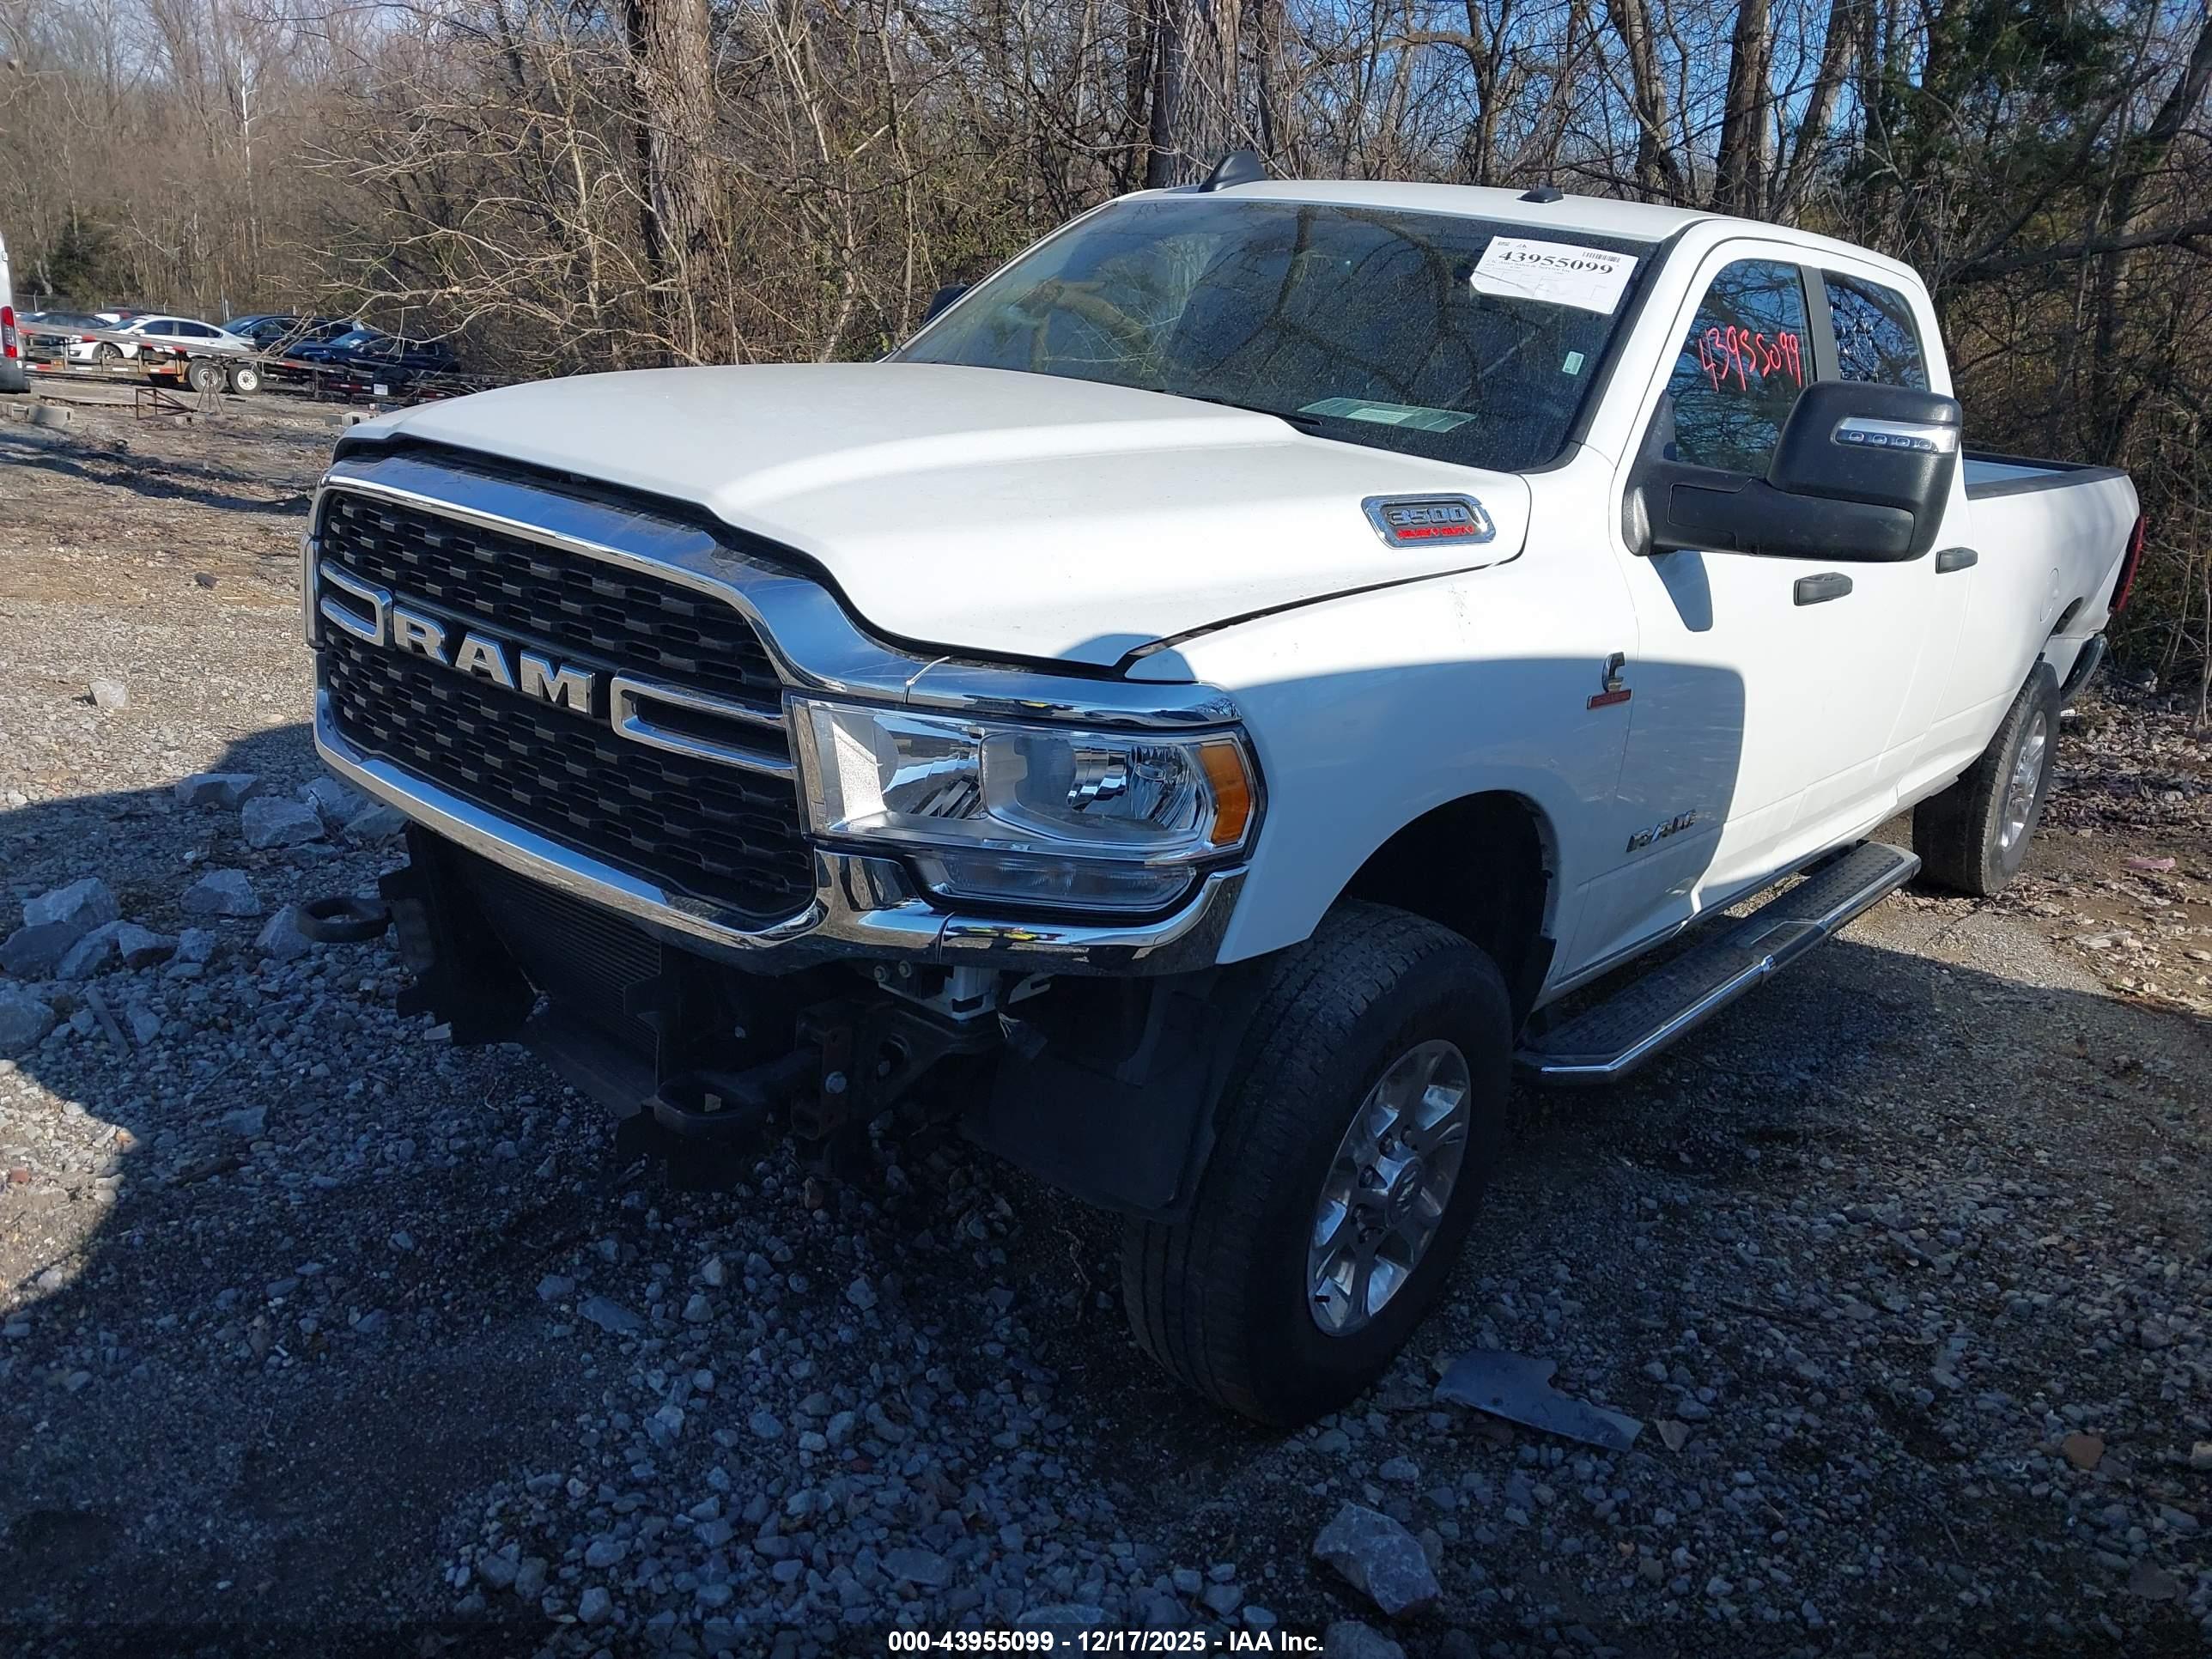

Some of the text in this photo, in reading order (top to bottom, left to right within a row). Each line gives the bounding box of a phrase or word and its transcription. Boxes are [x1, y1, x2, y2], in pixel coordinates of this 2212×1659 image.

[1498, 251, 1614, 276] 43955099
[1698, 325, 1802, 392] 43955099
[1387, 507, 1468, 526] 3500
[393, 605, 596, 715] RAM
